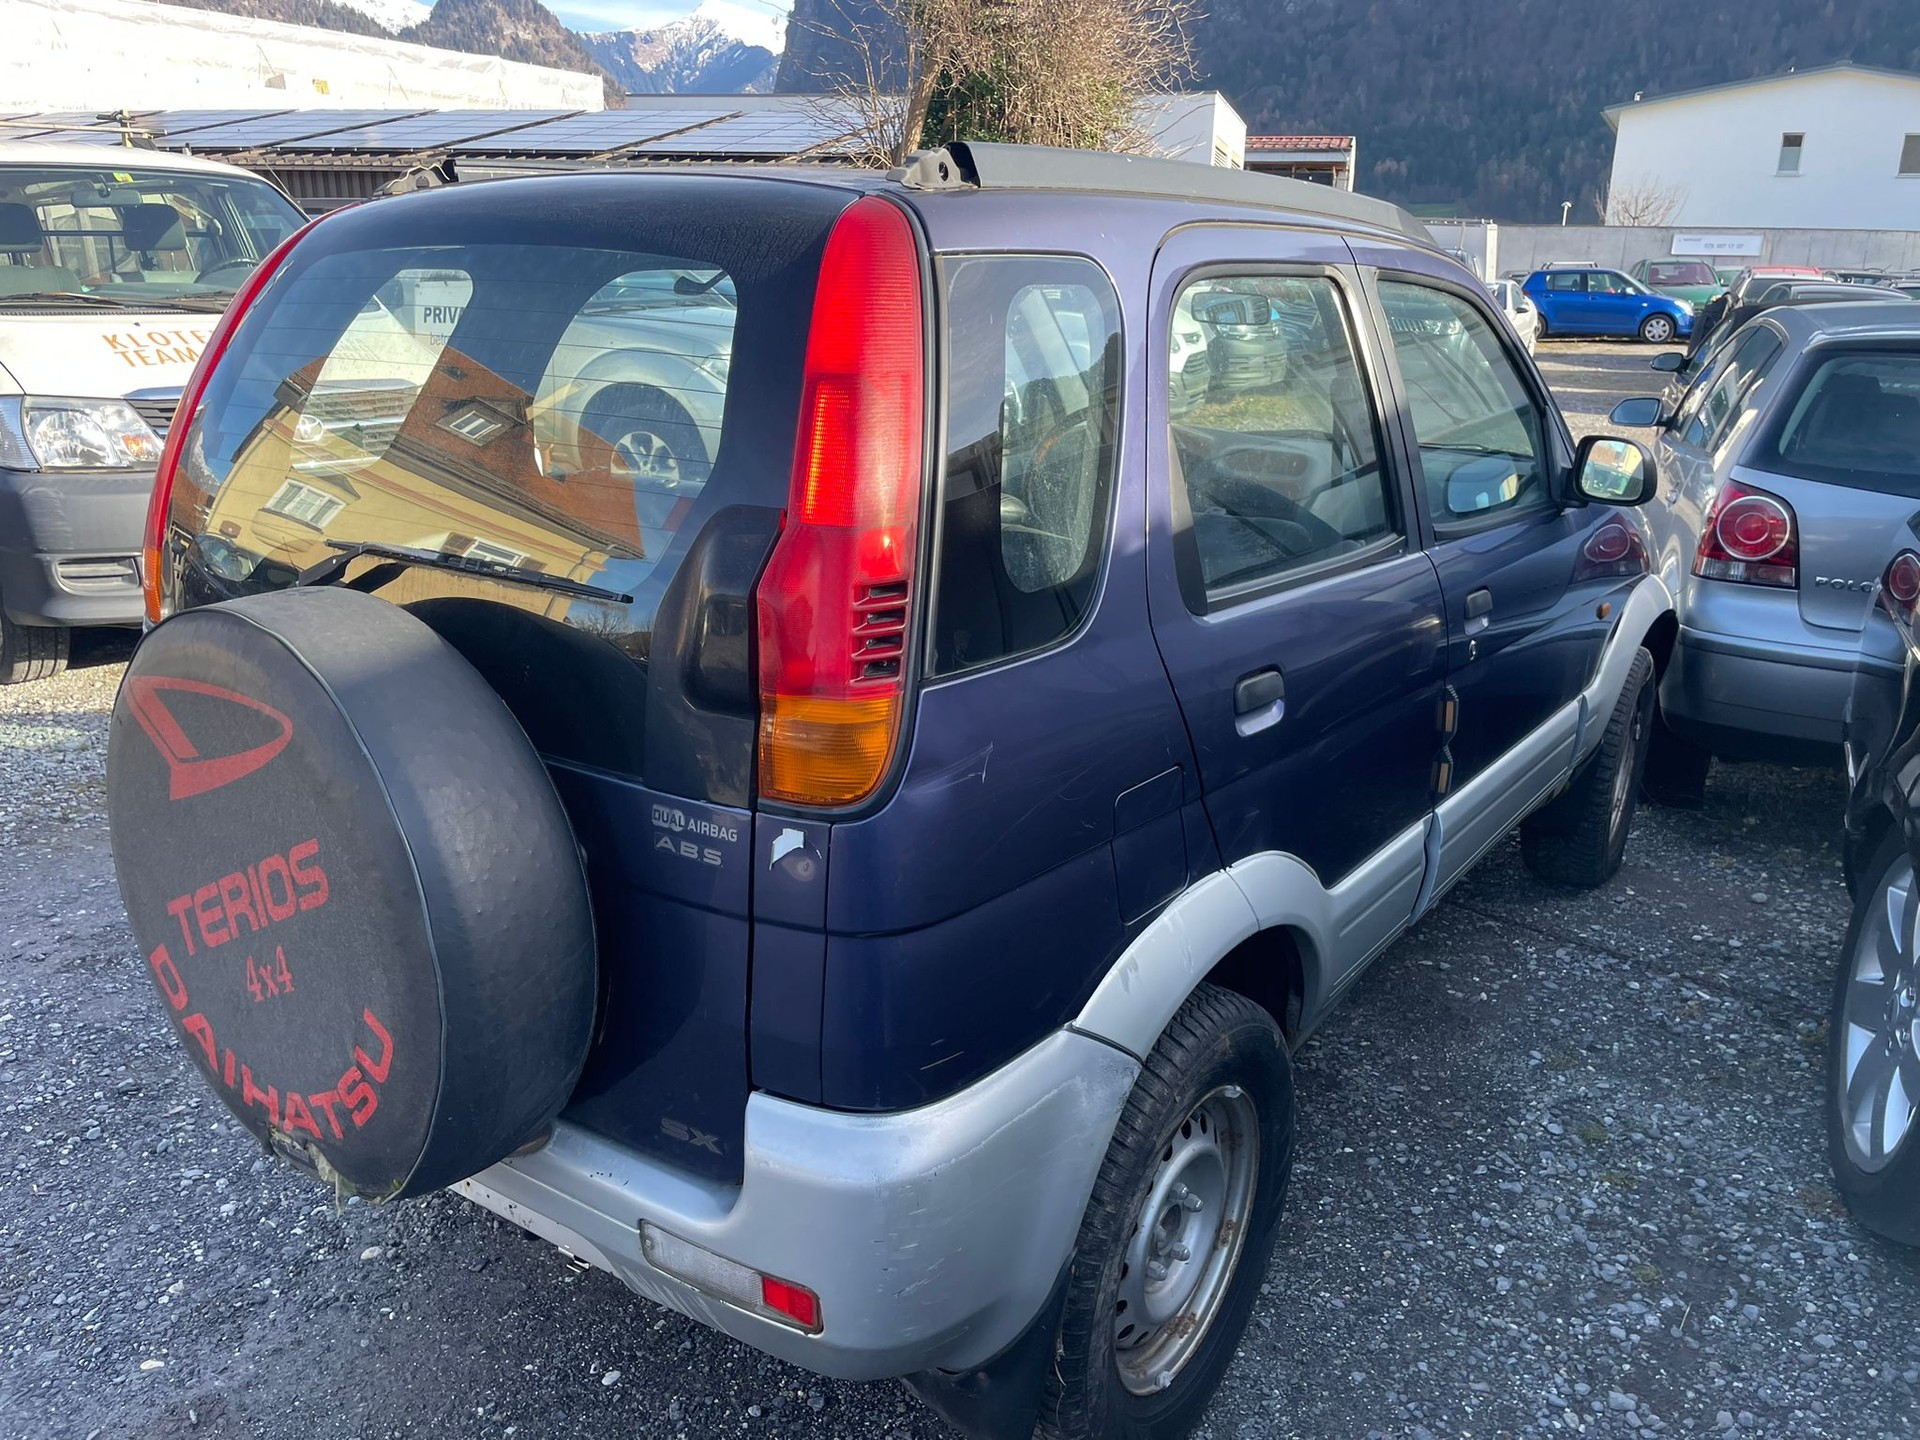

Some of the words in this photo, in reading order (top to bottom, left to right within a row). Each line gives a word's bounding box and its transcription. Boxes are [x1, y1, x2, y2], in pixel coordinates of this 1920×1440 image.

[114, 346, 200, 367] TEAM
[1815, 576, 1875, 593] POLO
[652, 806, 685, 830] DUAL
[687, 818, 738, 842] AIRBAG
[166, 838, 330, 956] TERIOS
[246, 945, 294, 1002] 4x4
[150, 943, 394, 1140] DAIHATSU
[660, 1117, 723, 1156] SX
